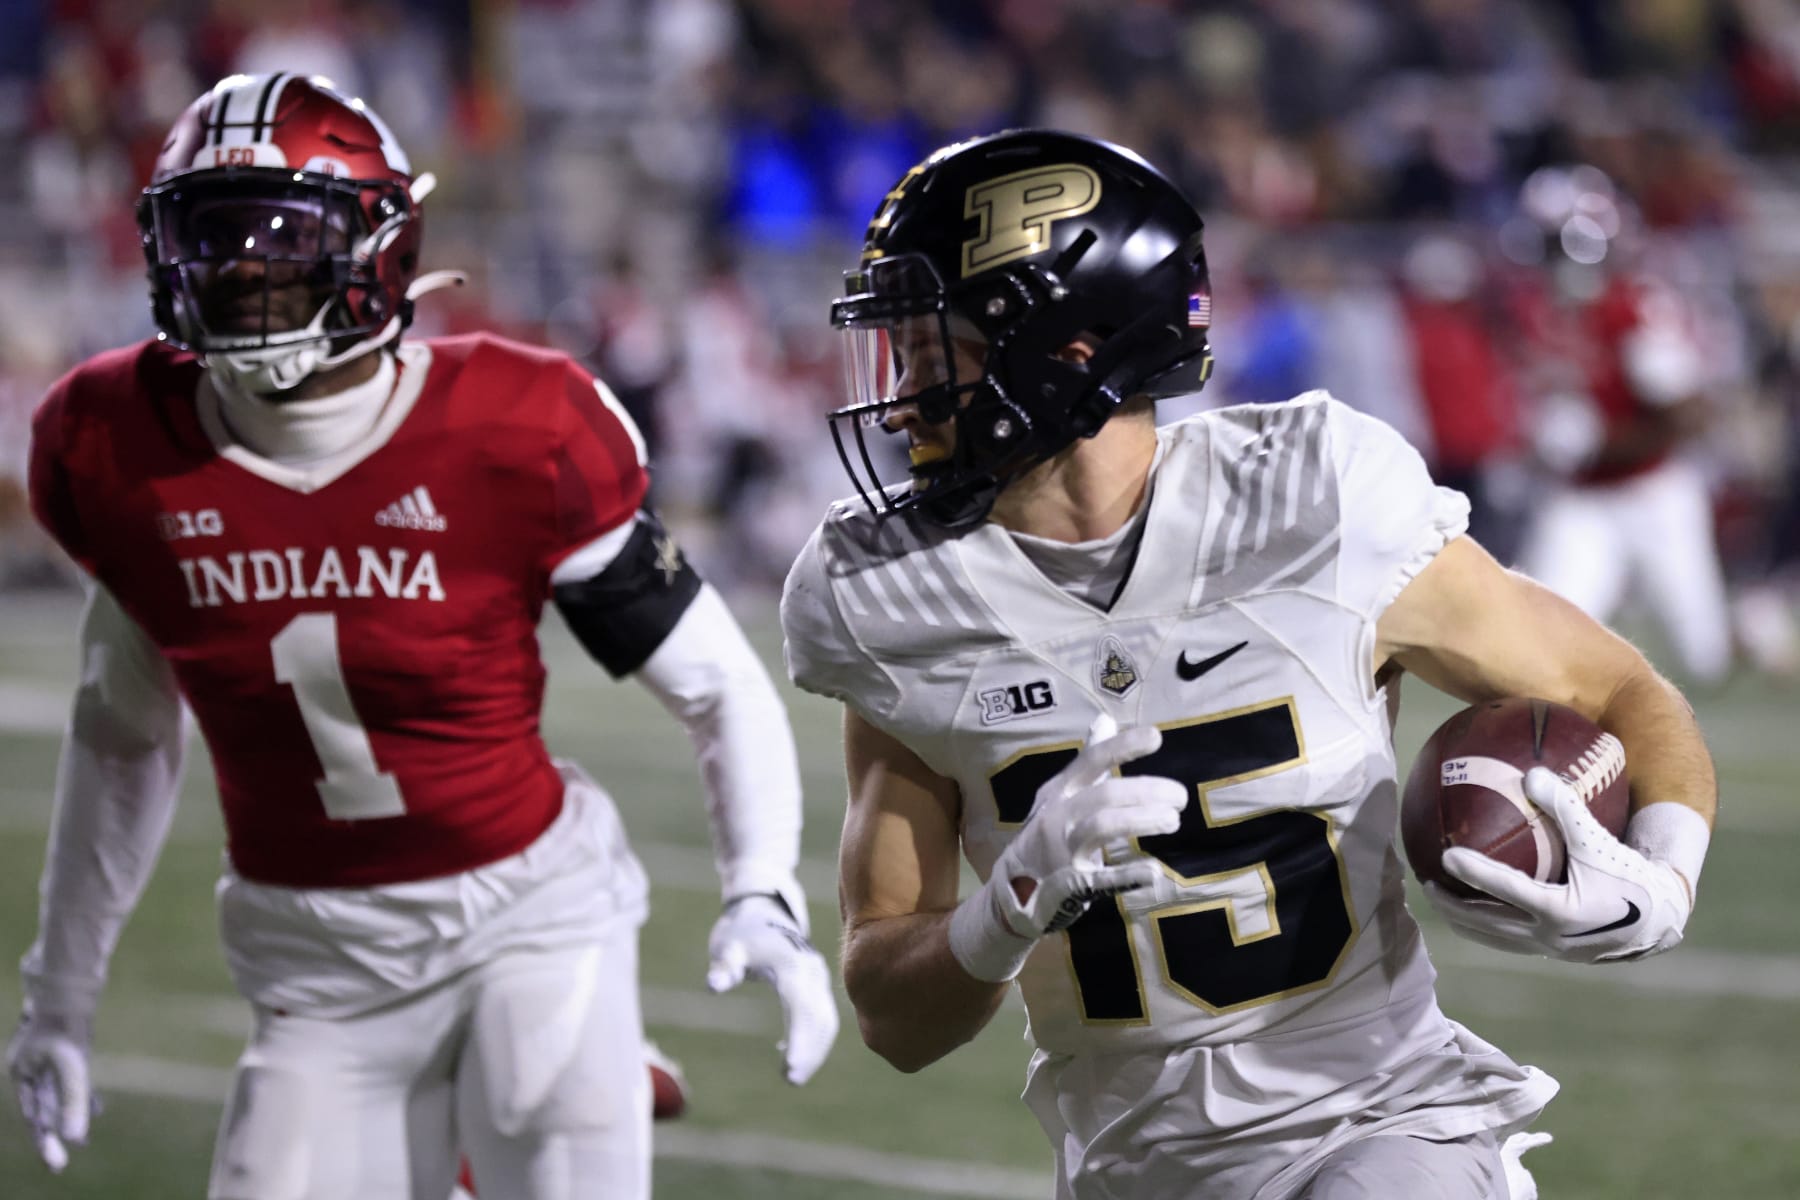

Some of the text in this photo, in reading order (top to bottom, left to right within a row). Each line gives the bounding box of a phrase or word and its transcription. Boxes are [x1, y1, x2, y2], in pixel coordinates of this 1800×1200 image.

[961, 163, 1102, 278] P
[375, 510, 448, 532] adidas
[179, 546, 446, 608] INDIANA
[270, 612, 407, 820] 1
